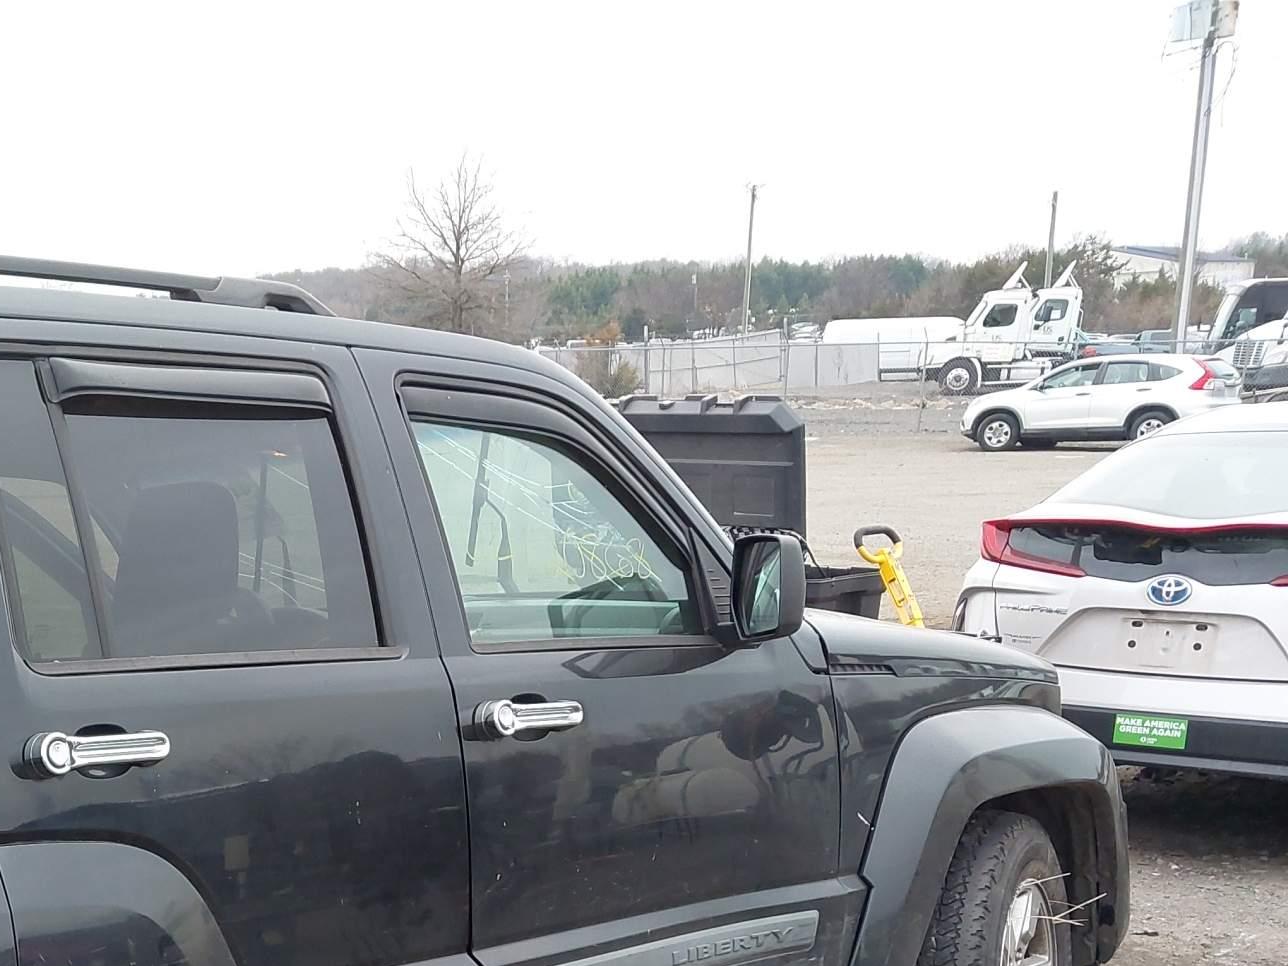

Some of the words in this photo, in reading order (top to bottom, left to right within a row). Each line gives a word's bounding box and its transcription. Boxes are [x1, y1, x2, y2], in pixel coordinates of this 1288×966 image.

[1116, 717, 1143, 726] MAKE
[1144, 720, 1186, 730] AMERICA
[1119, 726, 1150, 735] GREEN
[1151, 728, 1182, 738] AGAIN
[671, 926, 795, 966] LIBERTY
